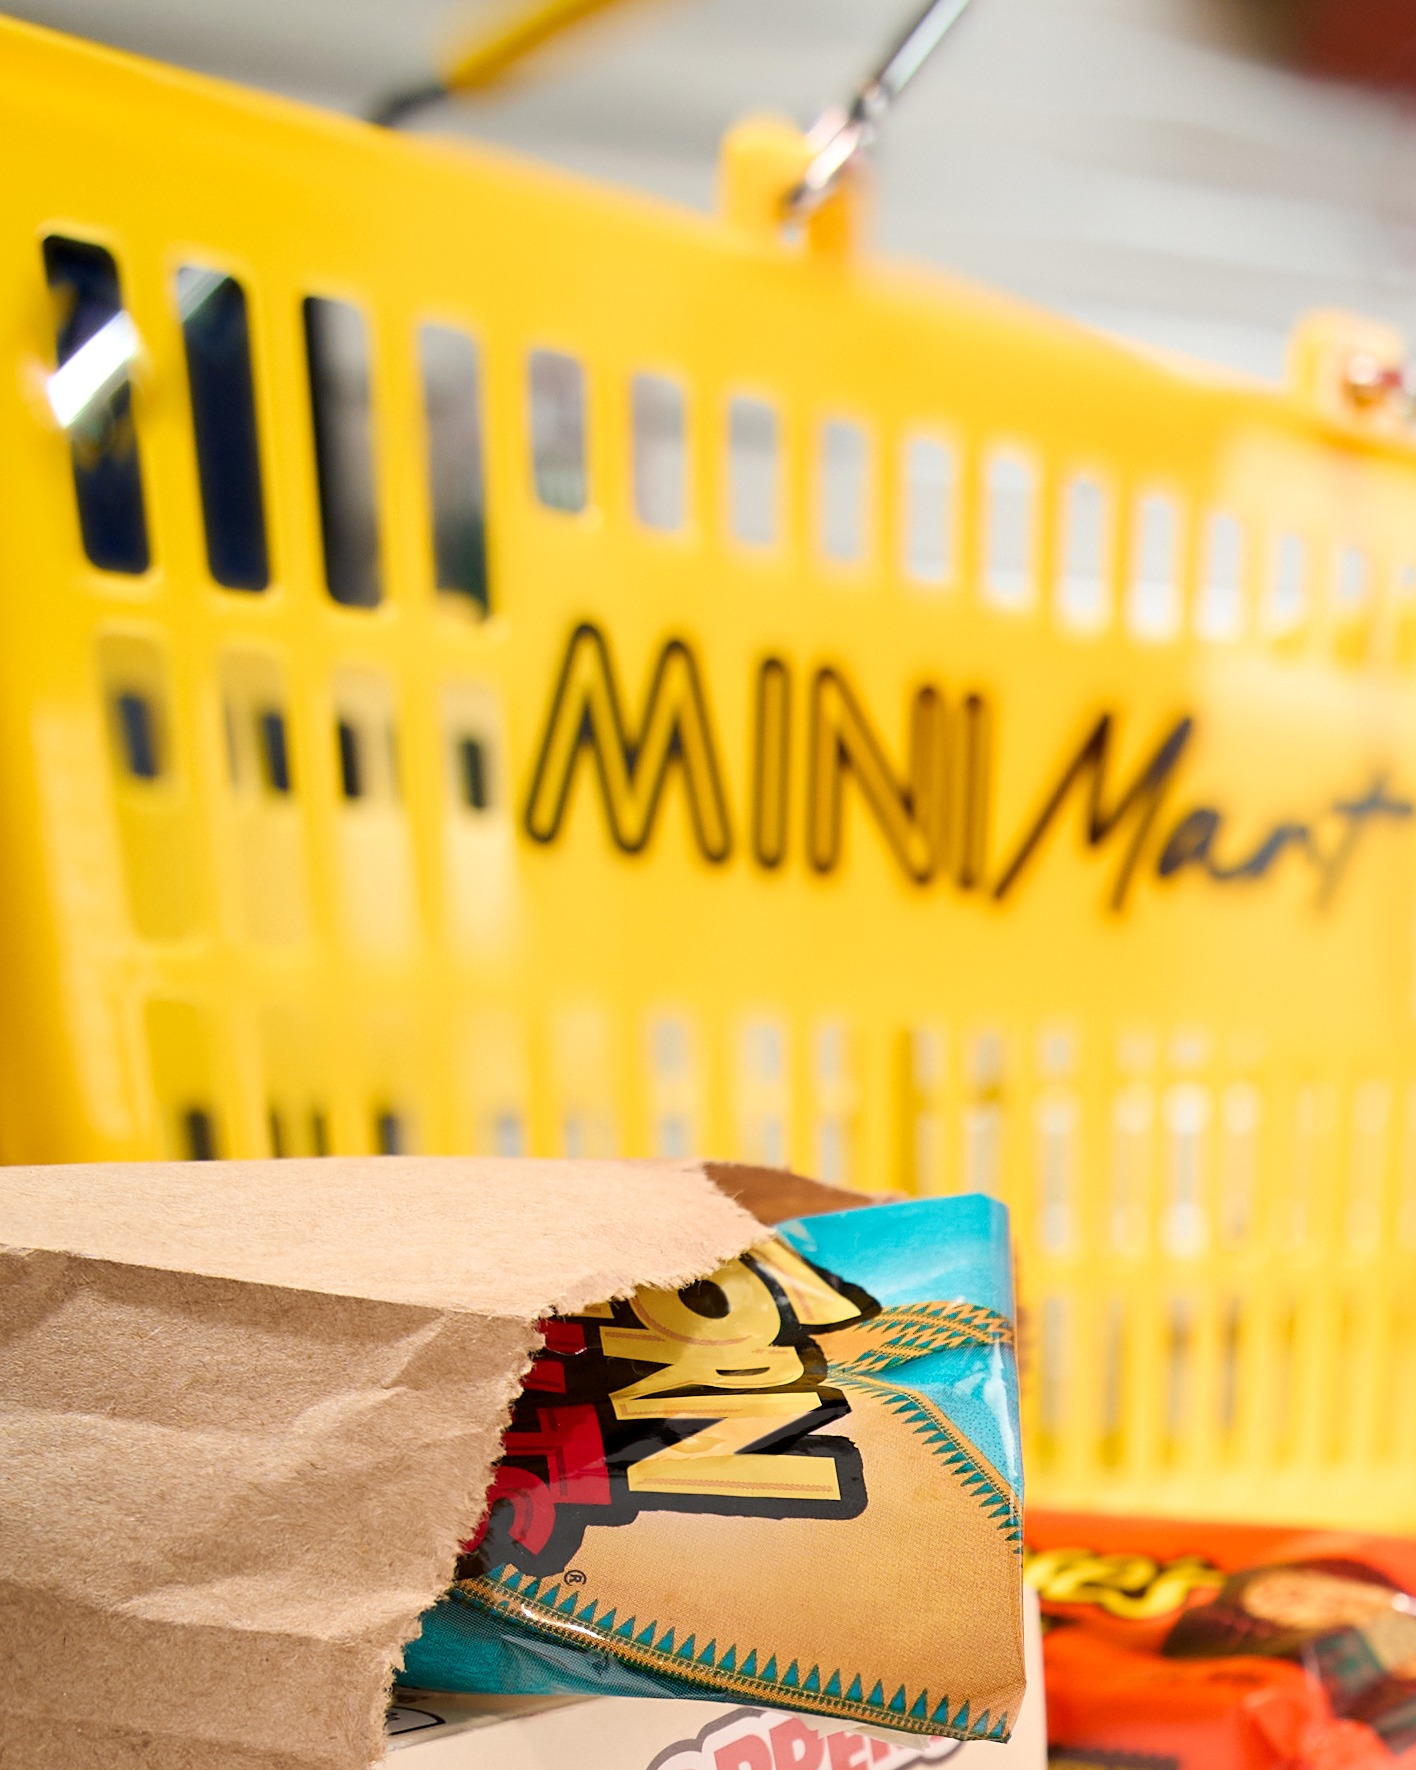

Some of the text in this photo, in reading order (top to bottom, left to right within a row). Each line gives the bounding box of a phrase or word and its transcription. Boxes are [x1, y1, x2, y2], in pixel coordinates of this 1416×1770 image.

[523, 623, 1415, 912] MINI Mart
[575, 1238, 862, 1501] ORN
